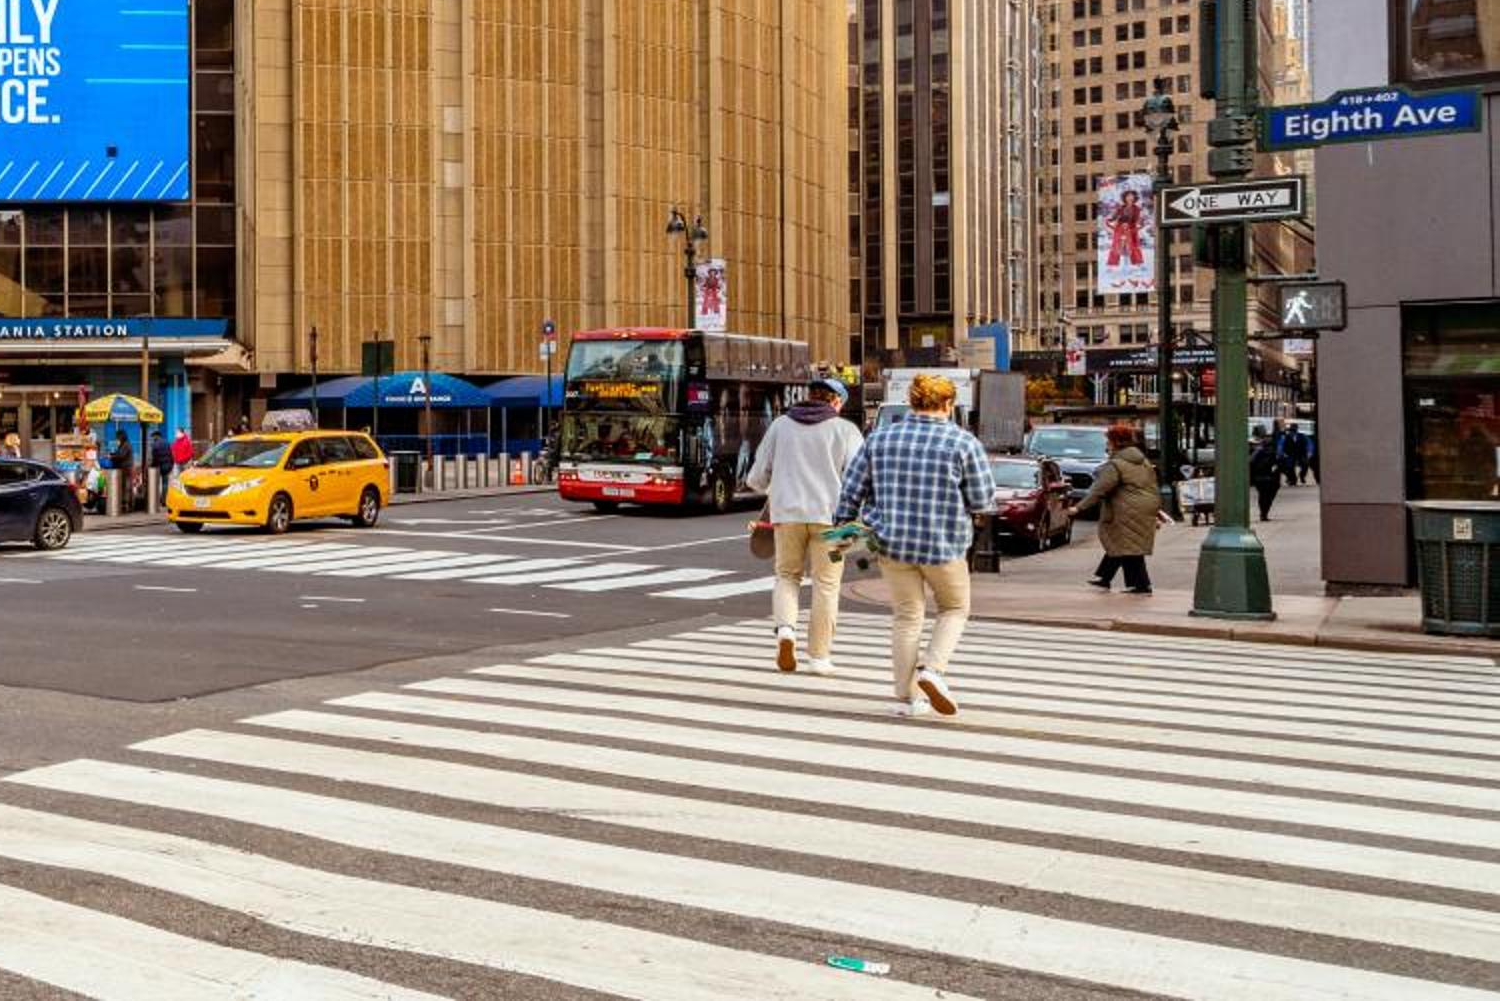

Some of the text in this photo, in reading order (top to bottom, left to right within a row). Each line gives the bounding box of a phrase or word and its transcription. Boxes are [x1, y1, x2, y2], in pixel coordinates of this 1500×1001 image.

[1285, 104, 1457, 140] Eighth Ave
[1183, 191, 1280, 210] ONE WAY
[53, 324, 128, 337] STATION
[409, 376, 427, 394] A
